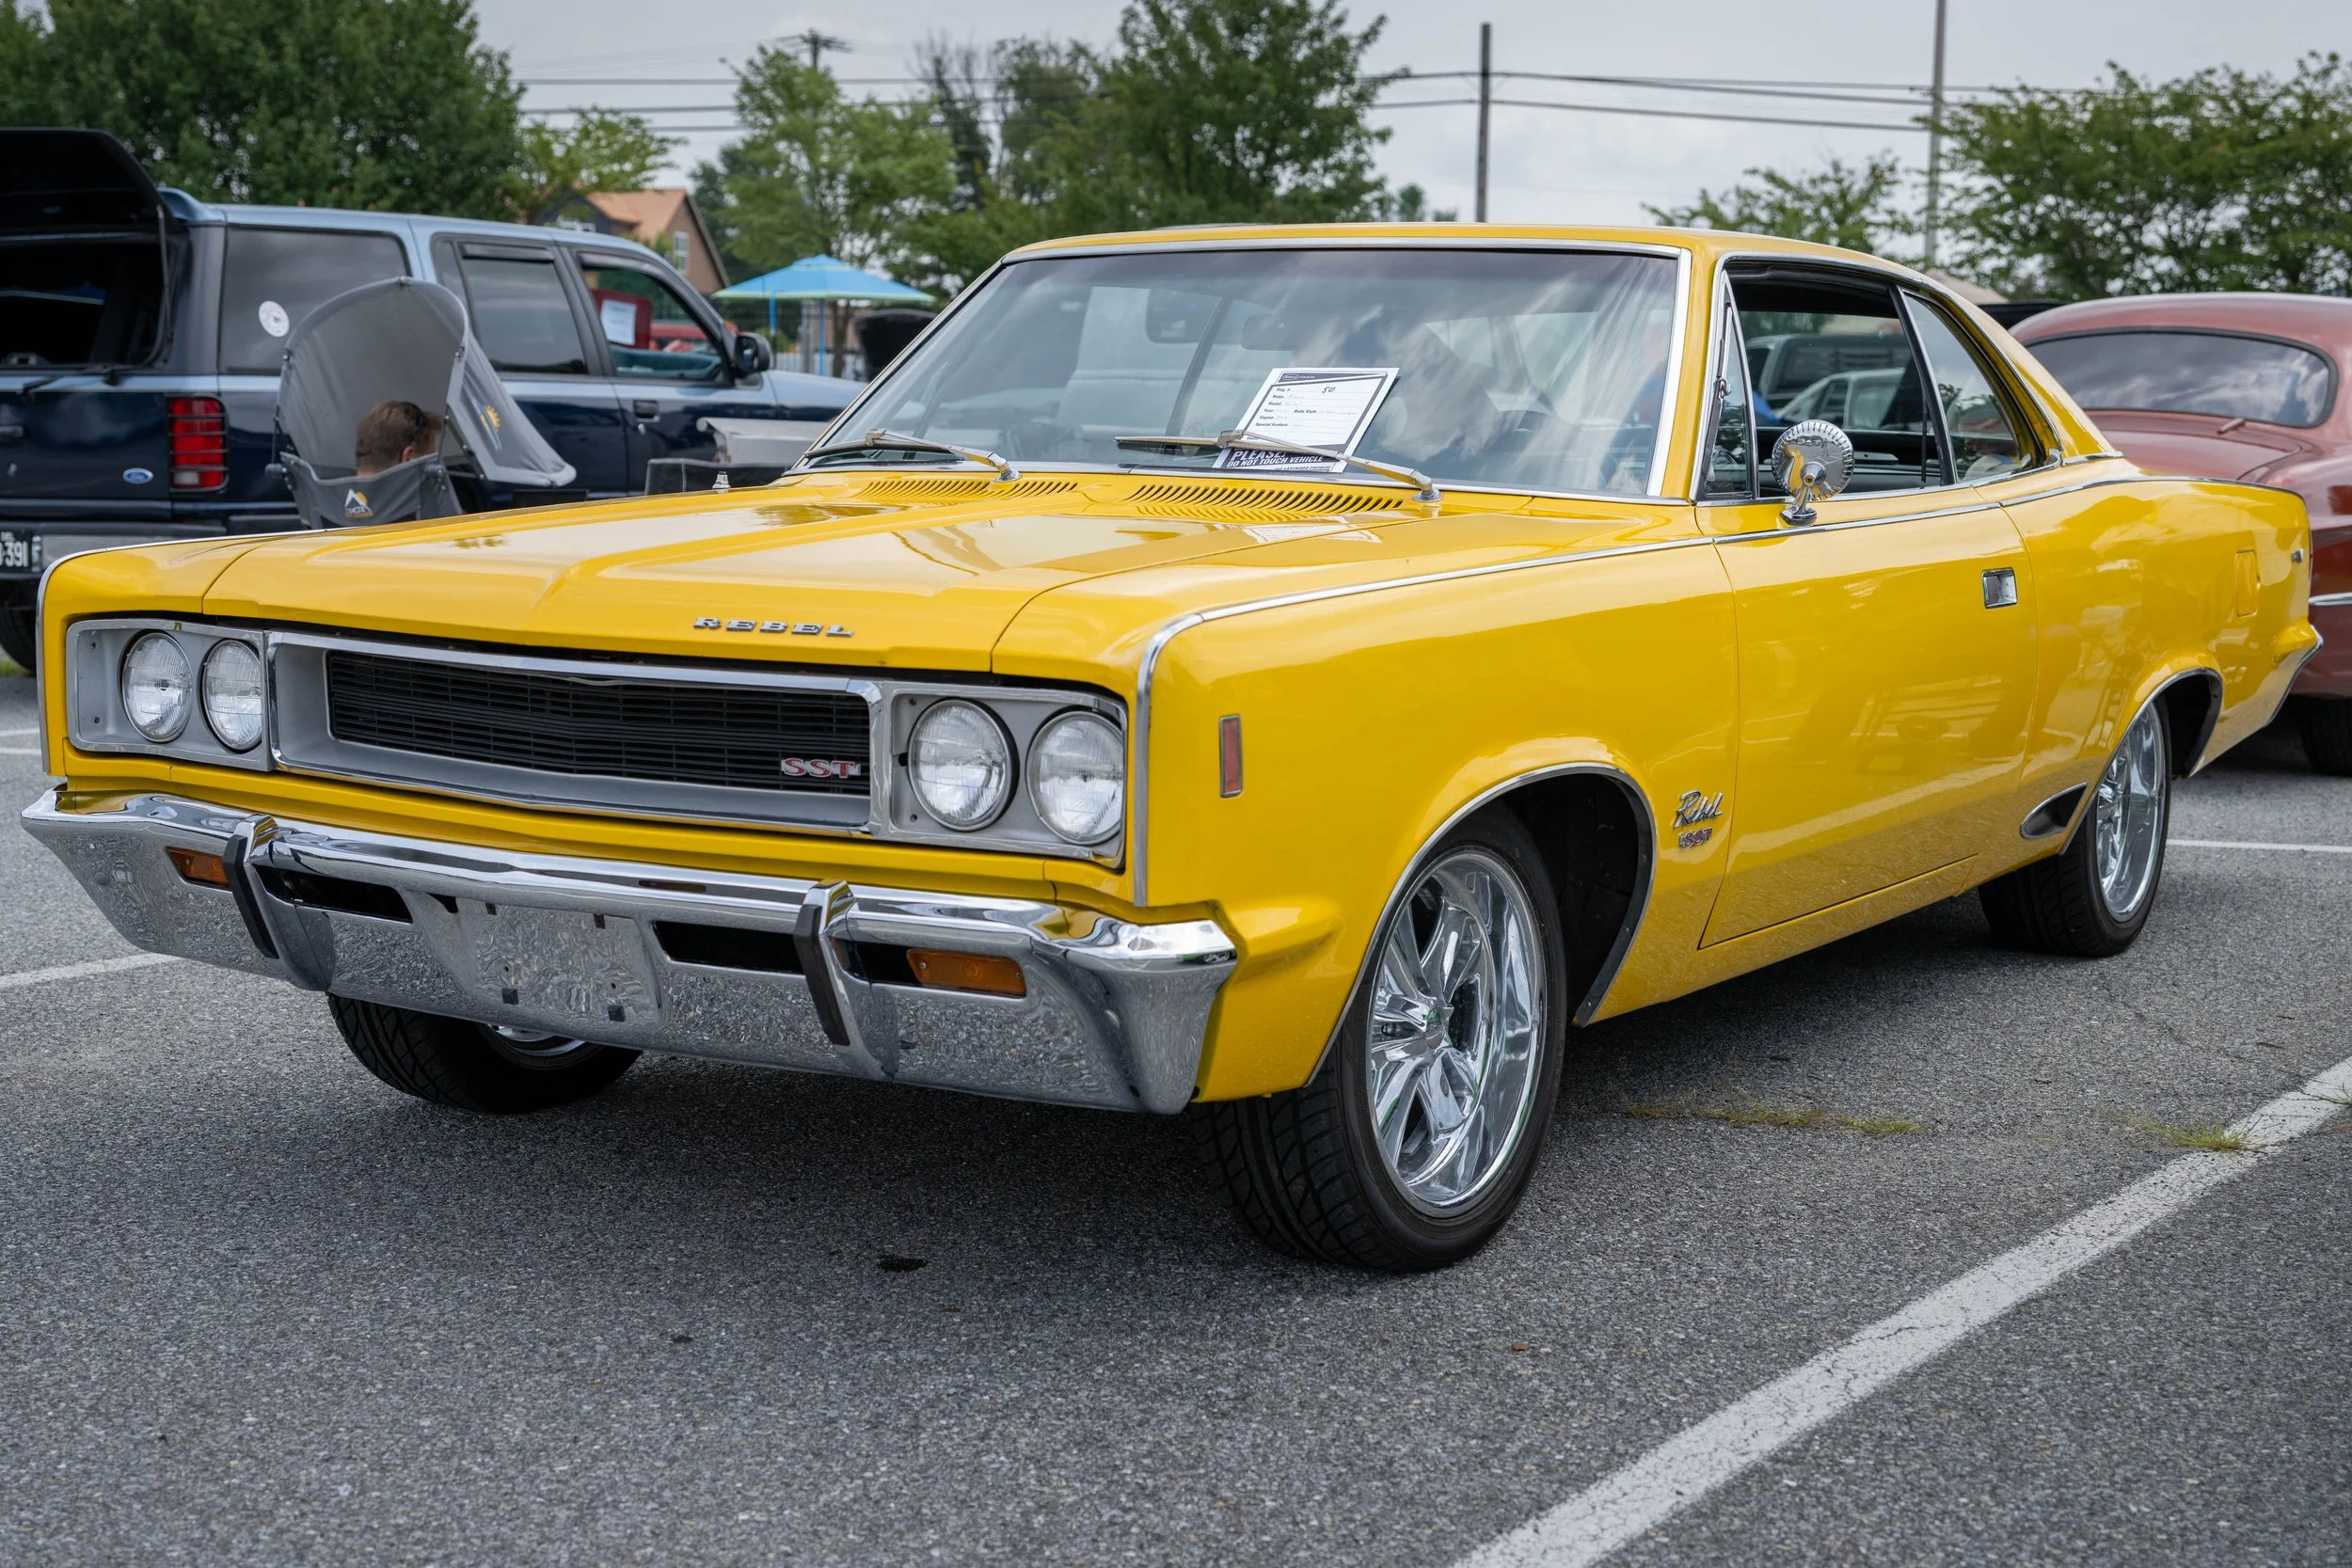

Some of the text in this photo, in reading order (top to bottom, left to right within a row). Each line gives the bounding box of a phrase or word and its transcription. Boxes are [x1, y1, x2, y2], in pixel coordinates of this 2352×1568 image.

[1231, 451, 1286, 461] PLEASE!
[1289, 455, 1323, 464] VEHICLE
[693, 617, 854, 637] REBEL
[783, 757, 857, 779] SST
[1683, 828, 1713, 847] SST
